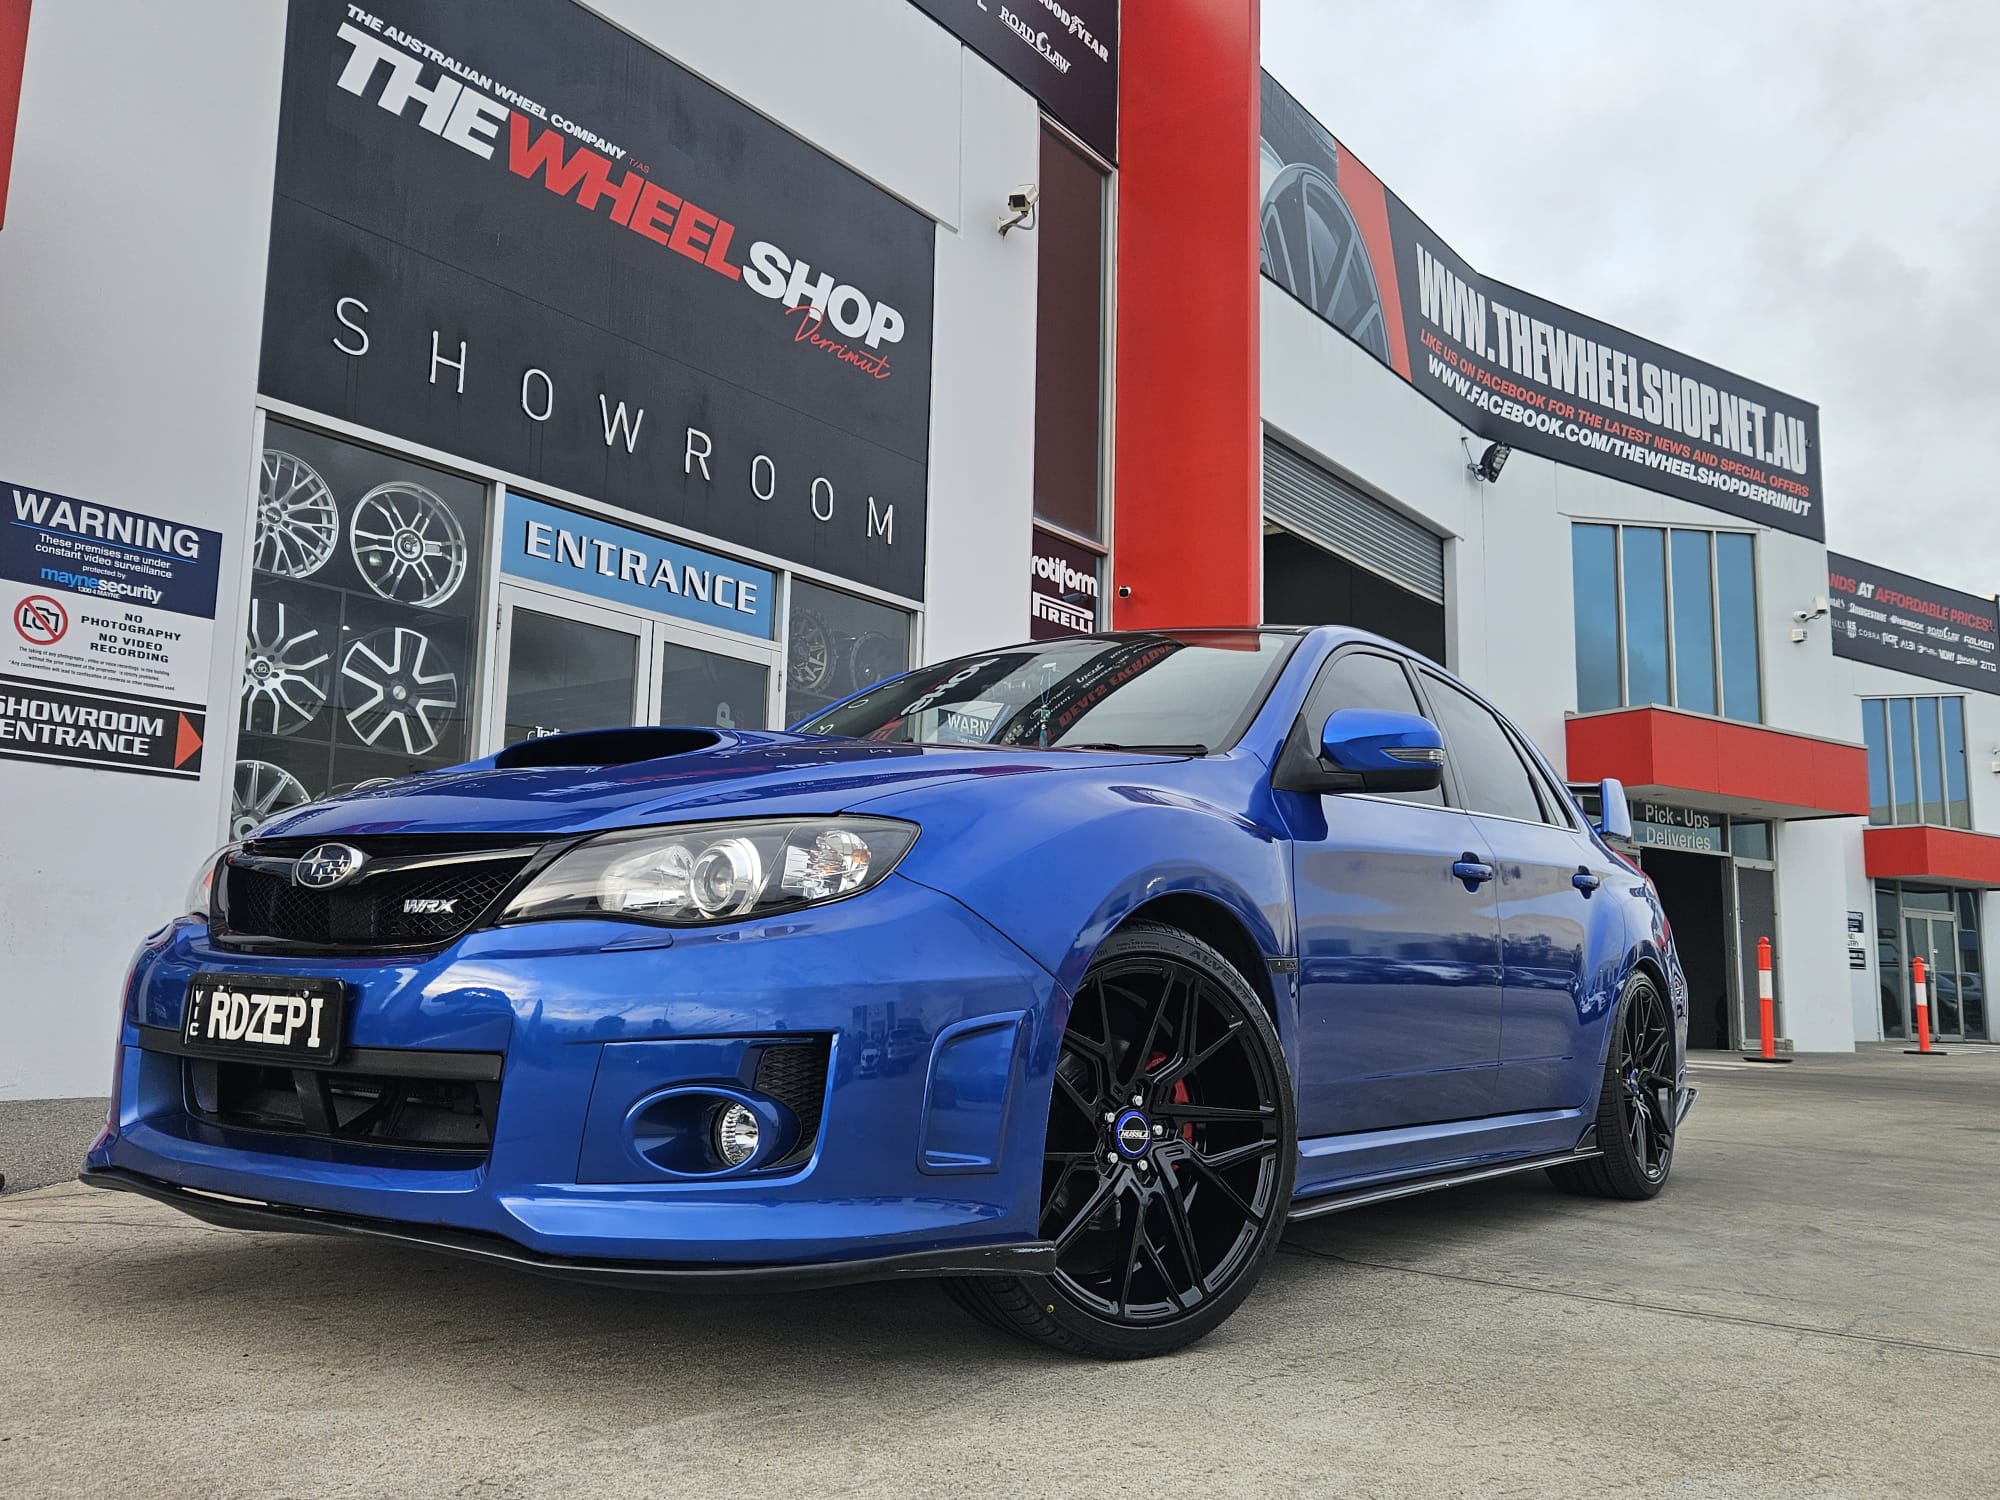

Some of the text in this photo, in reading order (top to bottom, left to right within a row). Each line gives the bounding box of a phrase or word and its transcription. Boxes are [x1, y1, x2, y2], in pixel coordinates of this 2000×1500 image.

[1038, 0, 1109, 63] OODYEAR
[347, 3, 651, 174] THE AUSTRALIAN WHEEL COMPANY T/AS
[784, 305, 891, 379] Derrimut
[1416, 242, 1807, 475] WWW.THEWHEELSHOP.NET.AU
[1420, 328, 1809, 498] LIKE US ON FACEBOOK FOR THE LATEST NEWS AND SPECIAL OFFERS
[12, 489, 199, 559] WARNING
[35, 544, 173, 578] constant video surveillance
[39, 533, 171, 569] These premises are under
[526, 520, 758, 614] ENTRANCE
[82, 565, 126, 580] protected by
[1031, 555, 1099, 598] rotiform
[124, 613, 143, 624] NO
[1032, 591, 1094, 634] PIRELLI
[1856, 582, 1875, 598] AT
[1875, 587, 1949, 620] AFFORDABLE
[80, 615, 182, 641] PHOTOGRAPHY
[98, 633, 163, 651] NO VIDEO
[90, 642, 169, 663] RECORDING
[0, 719, 151, 757] ENTRANCE
[1645, 804, 1674, 825] Pick
[1685, 808, 1710, 831] Ups
[1646, 826, 1711, 850] Deliveries
[403, 899, 458, 915] WRX
[189, 990, 204, 1036] VIC
